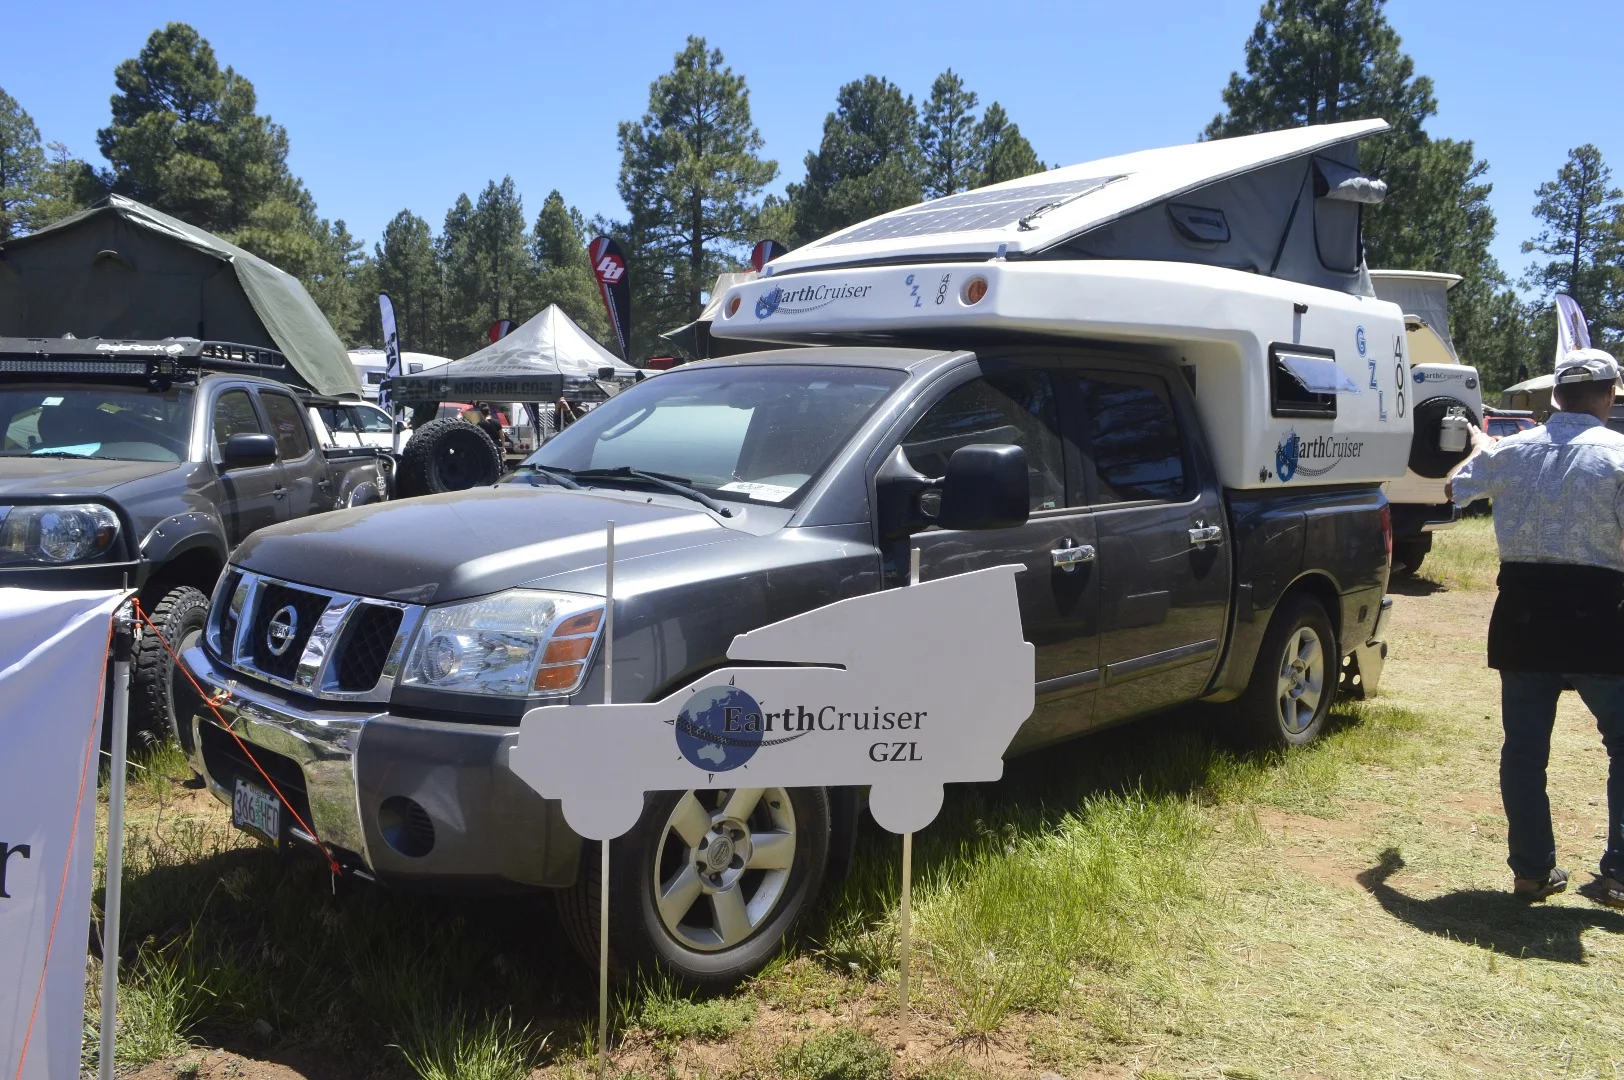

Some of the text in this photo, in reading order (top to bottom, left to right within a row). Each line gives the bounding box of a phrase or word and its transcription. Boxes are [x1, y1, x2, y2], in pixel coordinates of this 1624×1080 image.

[774, 283, 872, 304] EarthCruiser
[936, 273, 951, 306] 400
[1395, 335, 1405, 419] 400
[1421, 372, 1464, 381] EarthCruiser
[1291, 436, 1363, 460] EarthCruiser
[723, 705, 927, 733] EarthCruiser
[868, 742, 923, 763] GZL
[235, 789, 256, 824] 386
